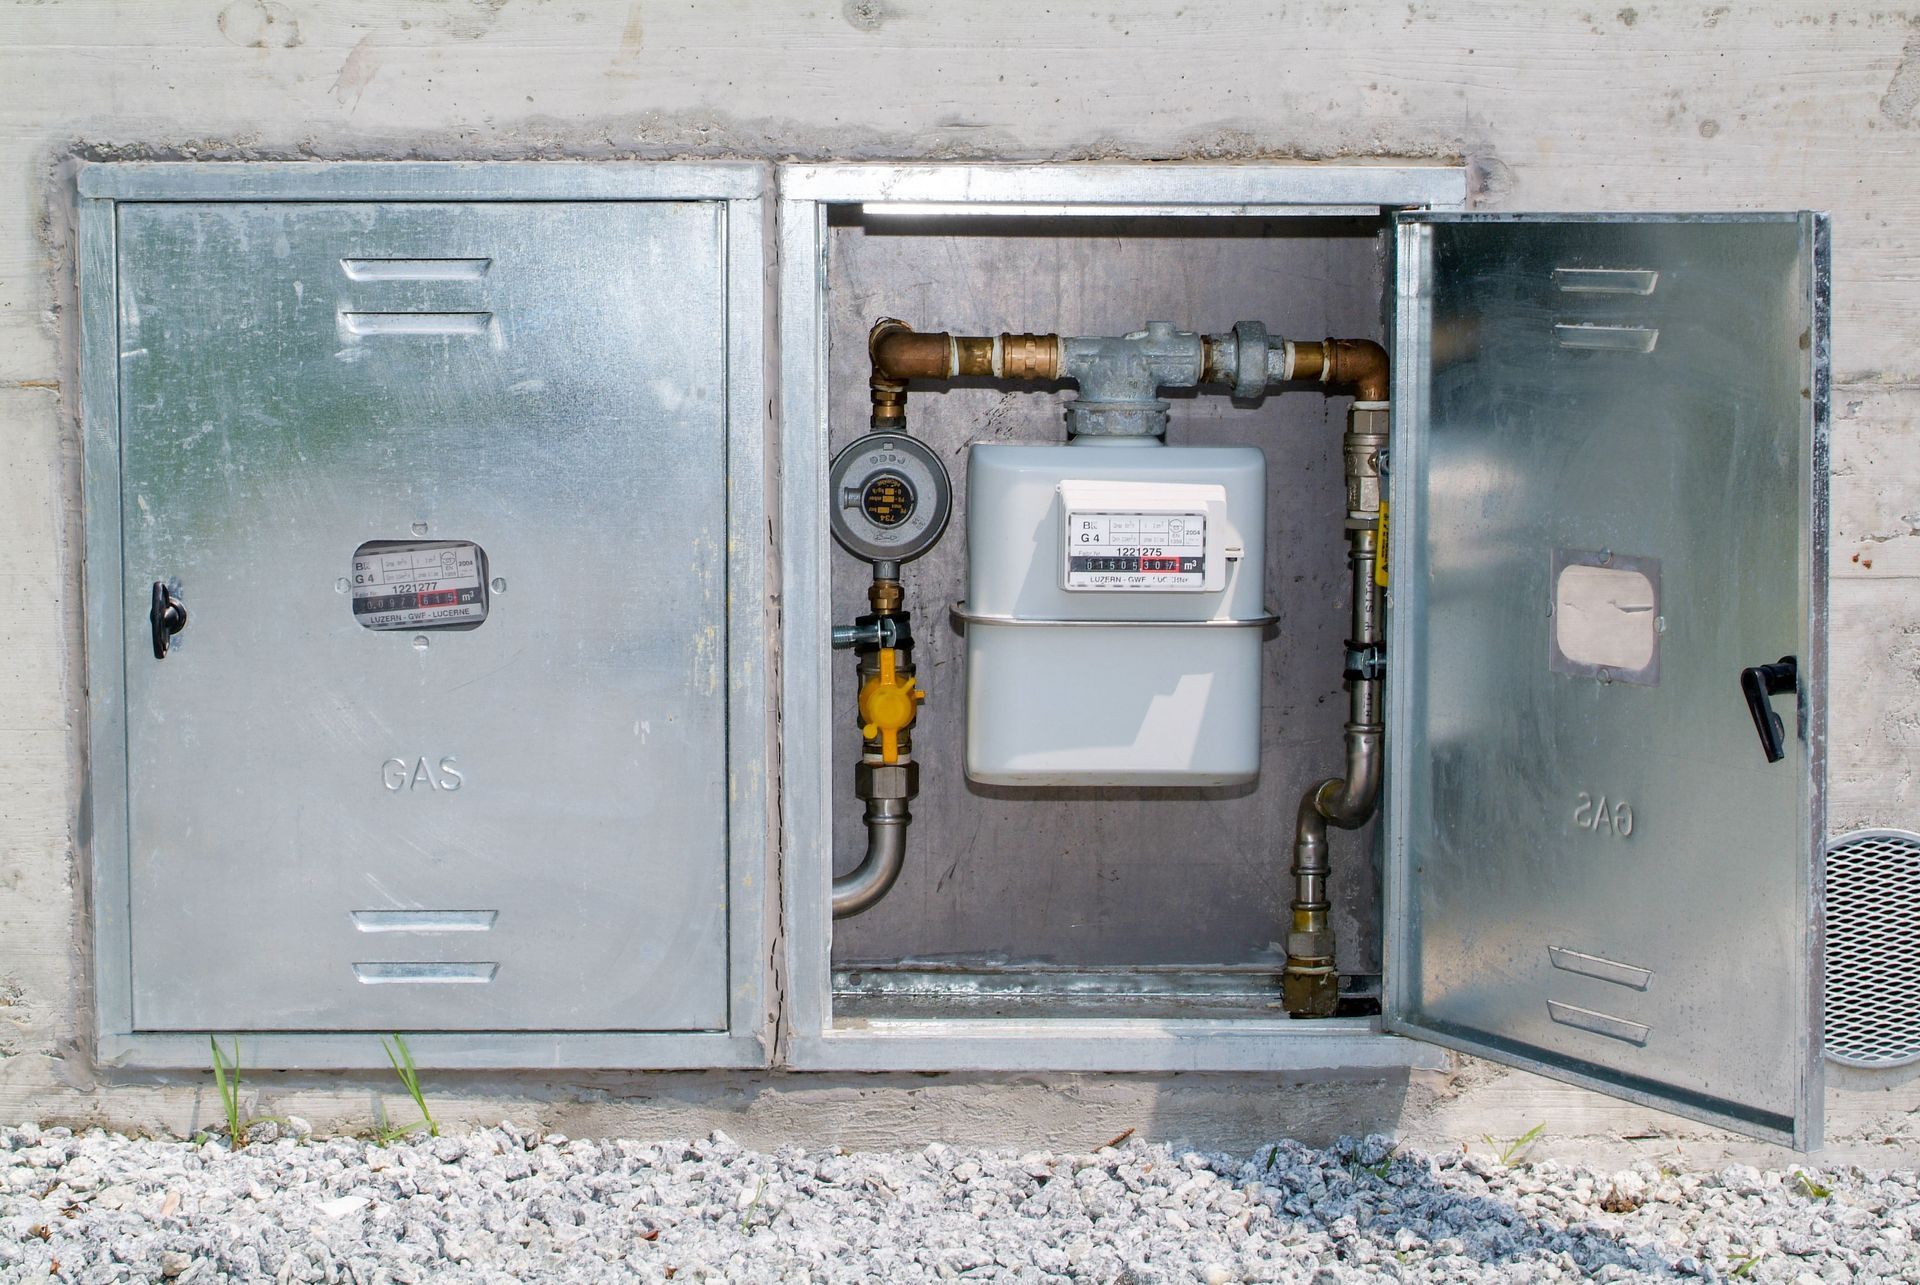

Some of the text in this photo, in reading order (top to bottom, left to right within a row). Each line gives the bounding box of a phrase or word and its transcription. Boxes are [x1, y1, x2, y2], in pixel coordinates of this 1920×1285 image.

[1081, 533, 1100, 543] G 4
[1116, 547, 1162, 557] 1221275
[355, 574, 374, 584] G 4
[393, 582, 437, 594] 1221277
[370, 613, 402, 624] LUZERN
[433, 608, 470, 618] LUCERNE
[381, 756, 464, 792] GAS
